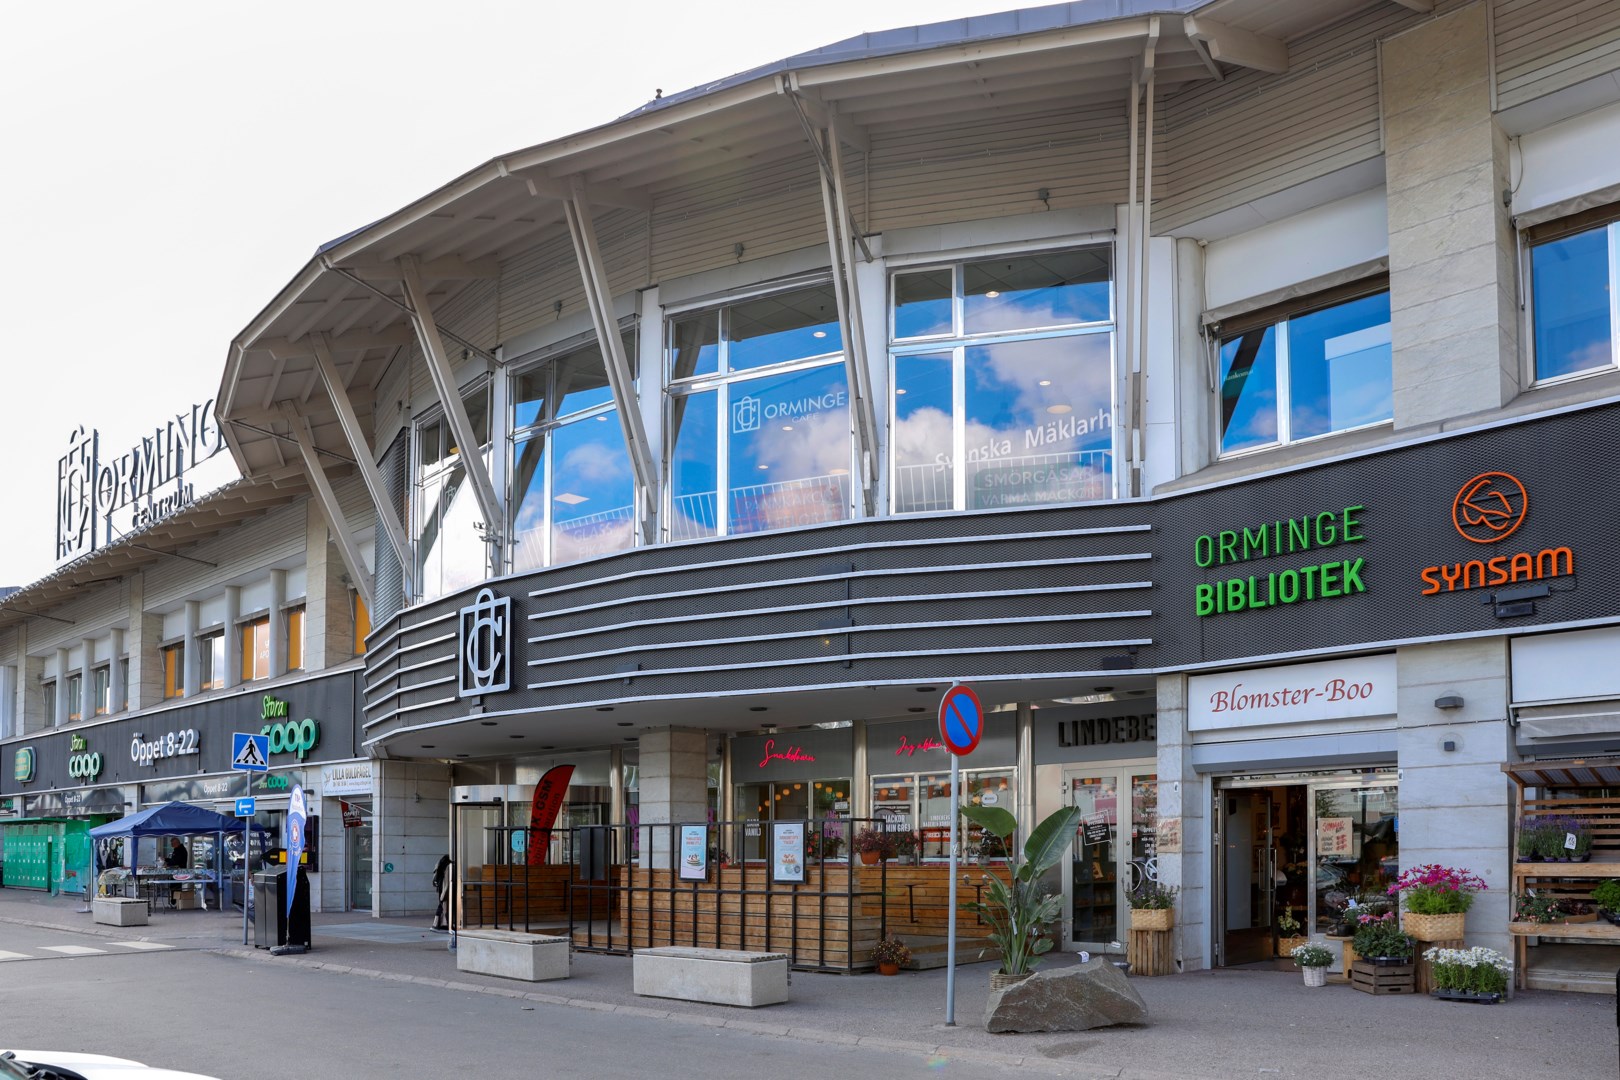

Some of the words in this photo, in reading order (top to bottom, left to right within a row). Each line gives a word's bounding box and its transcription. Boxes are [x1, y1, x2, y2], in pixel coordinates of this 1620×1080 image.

[764, 392, 845, 419] ORMINGE
[96, 398, 228, 518] ORMING
[935, 438, 1012, 472] Svnska
[132, 483, 194, 528] CENTRUM
[1195, 505, 1365, 567] ORMINGE
[1195, 557, 1366, 616] BIBLIOTEK
[1421, 547, 1573, 595] SYNSAM
[261, 695, 285, 720] Stora
[1210, 678, 1374, 712] Blomster-Boo
[131, 732, 164, 766] Öppet
[166, 728, 196, 757] 8-22
[69, 752, 100, 782] coop
[267, 775, 288, 790] coop
[204, 784, 217, 795] Öppet
